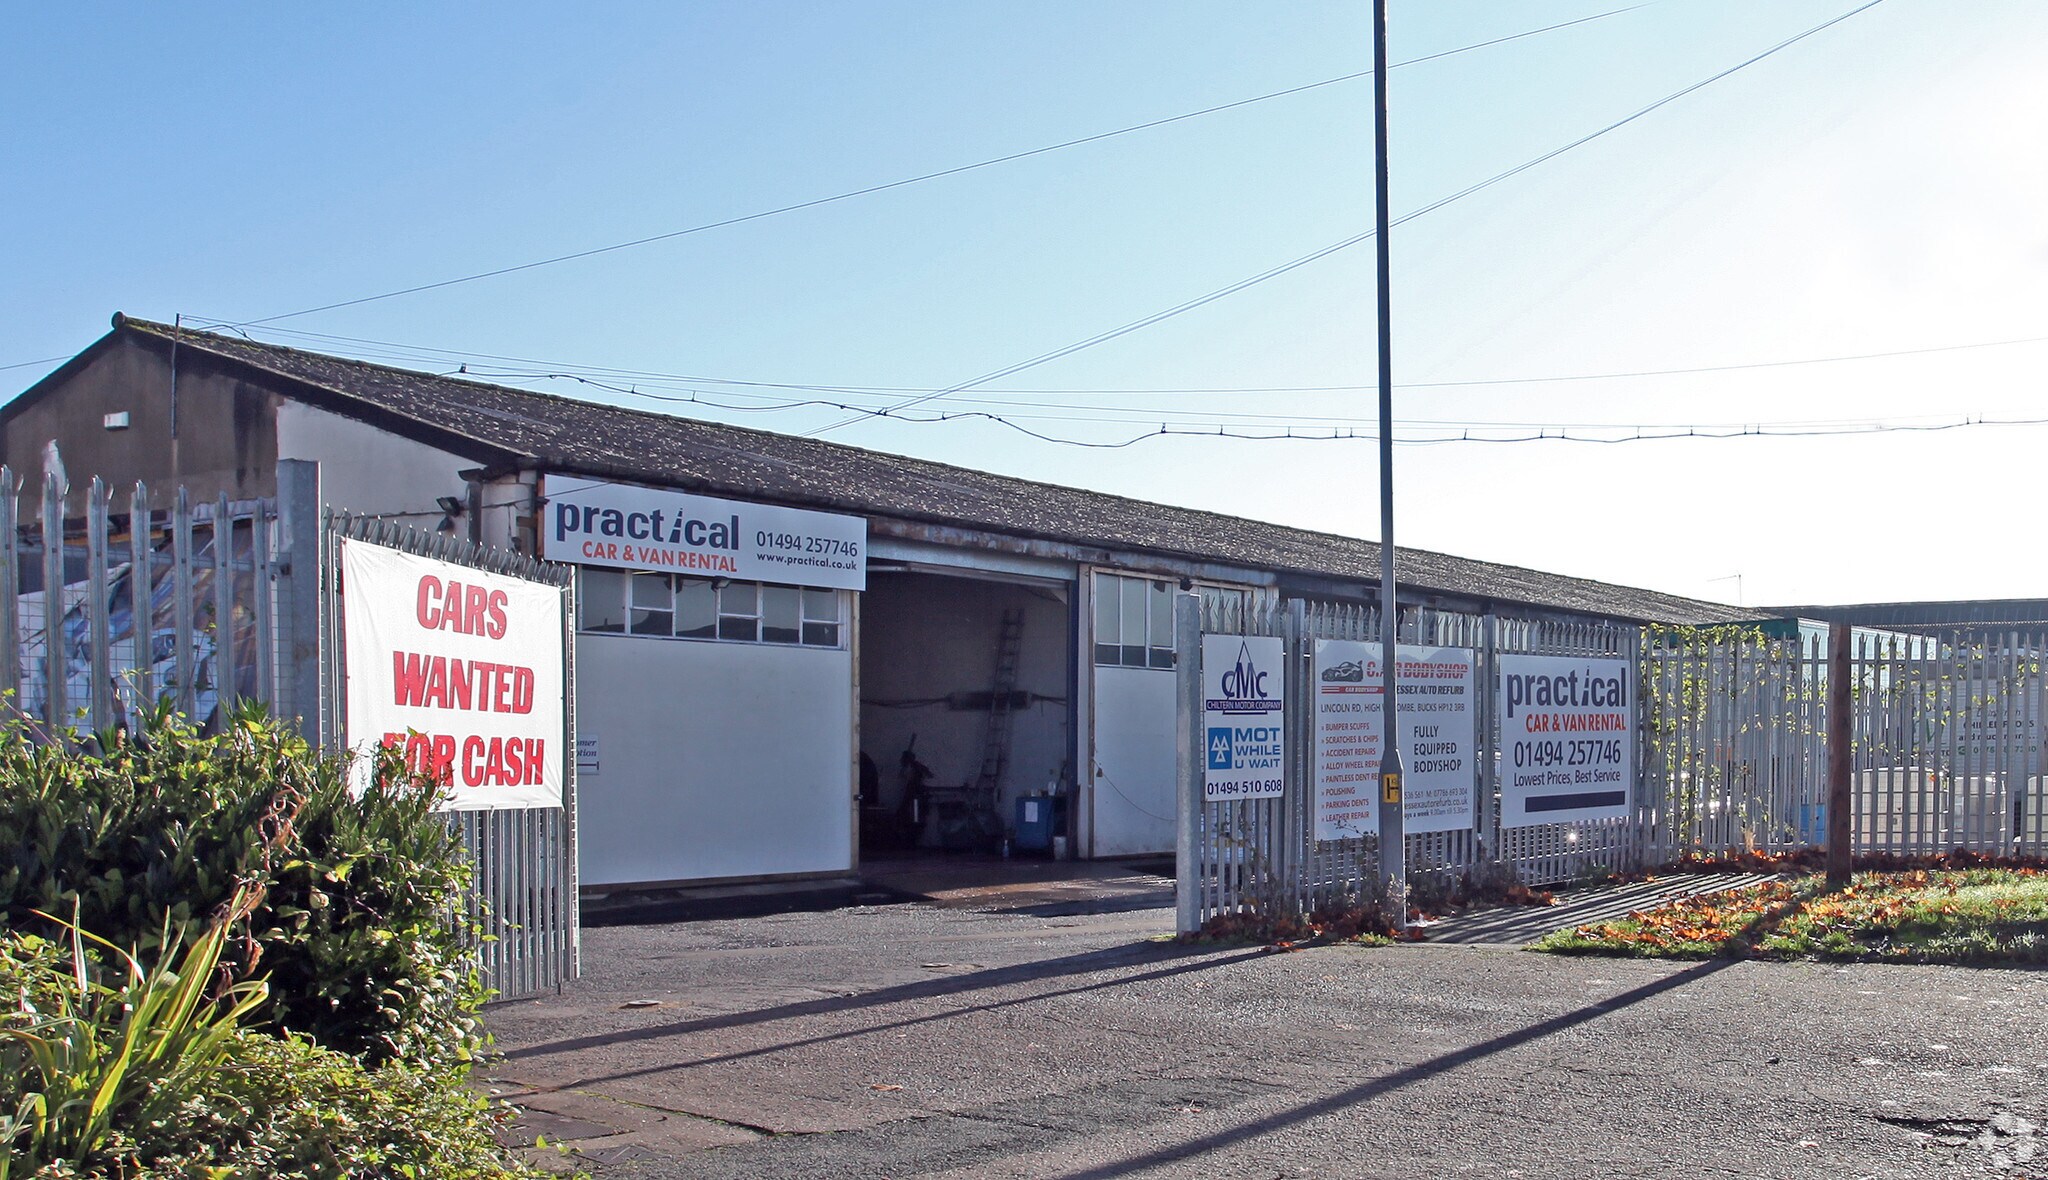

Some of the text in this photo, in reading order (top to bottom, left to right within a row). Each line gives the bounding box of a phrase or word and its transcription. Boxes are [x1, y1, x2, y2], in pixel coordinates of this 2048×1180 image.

[556, 502, 739, 550] practical
[756, 531, 858, 557] 01494 257746
[582, 541, 737, 573] CAR & VAN RENTAL
[757, 552, 857, 571] www.practical.co.uk
[417, 574, 508, 640] CARS
[1403, 662, 1468, 679] BODYSHOP
[393, 650, 535, 715] WANTED
[1221, 662, 1268, 699] CMC
[1420, 685, 1436, 695] AUTO
[1438, 685, 1464, 695] REFURB
[1507, 666, 1626, 718] practical
[1207, 701, 1281, 710] CHILTERN MOTOR COMPANY
[1321, 704, 1350, 713] LINCOLN
[1365, 704, 1380, 713] HIGH
[1418, 703, 1437, 712] BUCKS
[1326, 722, 1370, 731] BUMPER SCUFFS
[1526, 713, 1626, 733] CAR & VAN RENTAL
[1235, 728, 1280, 742] MOT
[1414, 726, 1439, 738] FULLY
[1326, 736, 1357, 744] SCRATCHES
[1363, 735, 1379, 743] CHIPS
[1235, 745, 1281, 756] WHILE
[1326, 748, 1376, 757] ACCIDENT REPAIRS
[1414, 743, 1457, 756] EQUIPPED
[1514, 740, 1621, 767] 01494 257746
[461, 735, 545, 788] CASH
[1235, 758, 1281, 769] U WAIT
[1326, 762, 1343, 770] ALLOY
[1345, 761, 1363, 769] WHEEL
[1414, 759, 1462, 773] BODYSHOP
[1326, 774, 1354, 783] PAINTLESS
[1355, 773, 1370, 781] DENT
[1514, 768, 1621, 787] Lowest Prices, Best Service
[1207, 779, 1282, 795] 01494 510 608
[1326, 787, 1355, 796] POLISHING
[1326, 799, 1369, 809] PARKING DENTS
[1326, 812, 1370, 822] LEATHER REPAIR
